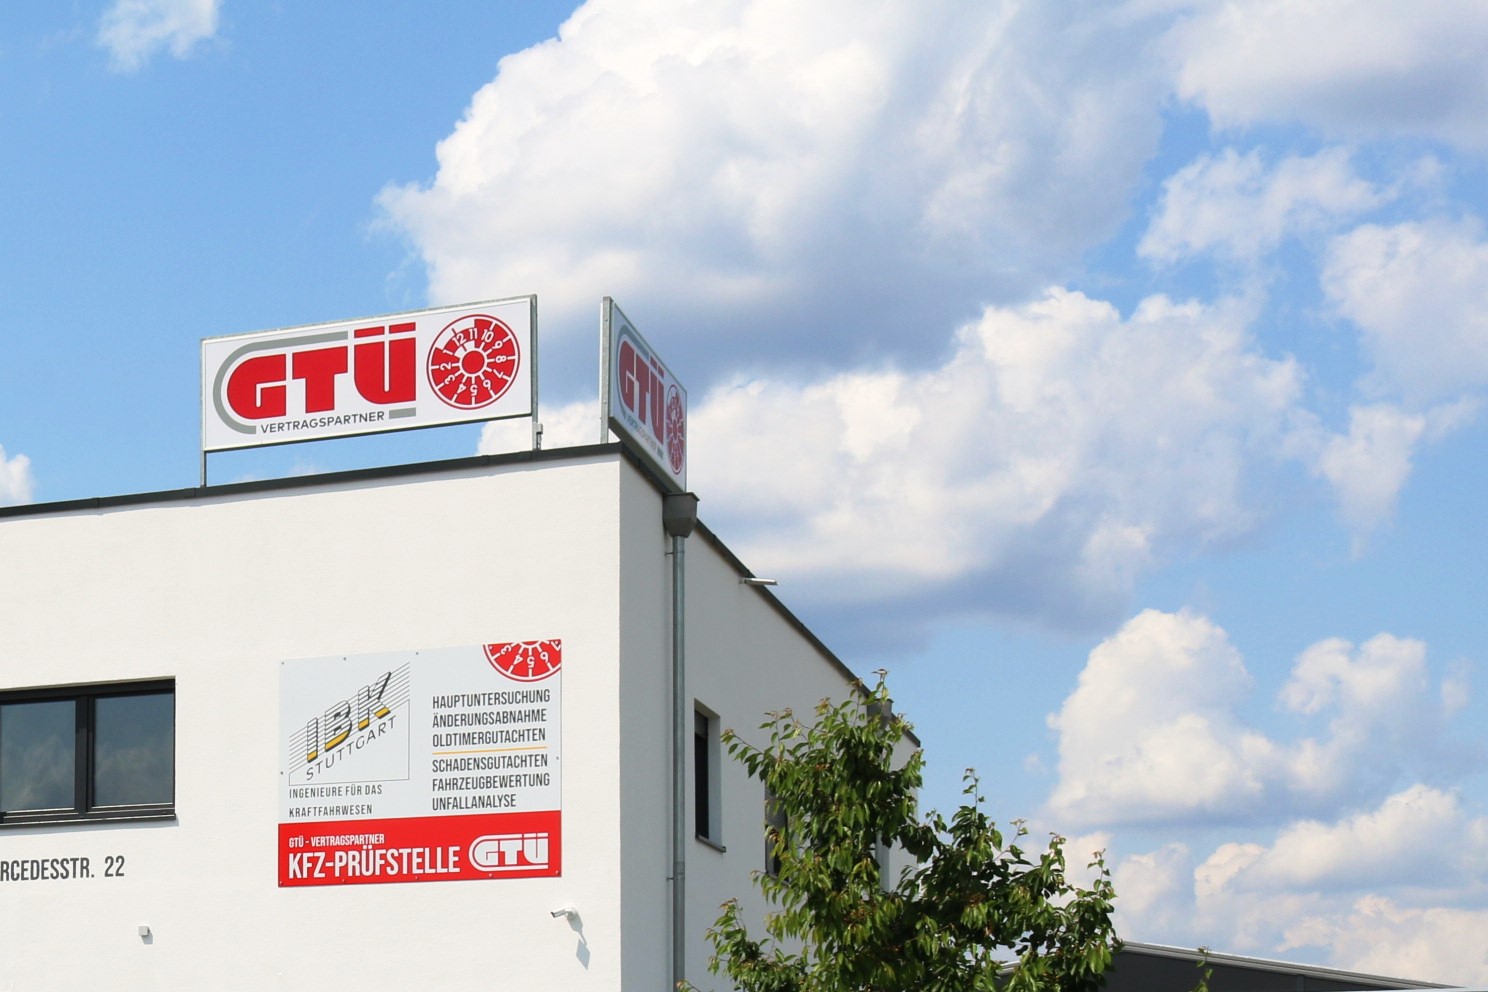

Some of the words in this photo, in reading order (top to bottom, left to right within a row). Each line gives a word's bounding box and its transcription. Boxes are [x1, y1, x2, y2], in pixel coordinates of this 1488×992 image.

[452, 333, 467, 347] 12
[469, 328, 478, 339] 11
[481, 329, 494, 343] 10
[440, 361, 451, 371] 2
[495, 355, 507, 363] 8
[226, 322, 416, 419] GTÜ
[493, 369, 504, 379] 7
[444, 374, 455, 385] 3
[456, 383, 467, 394] 4
[470, 384, 478, 396] 5
[619, 340, 665, 446] GTÜ
[260, 410, 385, 435] VERTRAGSPARTNER
[500, 644, 512, 655] 3
[512, 654, 524, 665] 4
[527, 656, 535, 668] 5
[432, 688, 551, 710] HAUPTUNTERSUCHUNG
[307, 671, 392, 763] IBK
[432, 708, 547, 728] ÄNDERUNGSABNAHME
[432, 727, 546, 748] OLDTIMERGUTACHTEN
[306, 715, 396, 781] STUTTGART
[432, 753, 548, 773] SCHADENSGUTACHTEN
[432, 772, 551, 792] FAHRZEUGBEWERTUNG
[288, 786, 343, 799] INGENIEURE
[345, 784, 362, 797] FÜR
[365, 784, 382, 796] DAS
[432, 793, 517, 811] UNFALLANALYSE
[288, 804, 373, 818] KRAFTFAHRWESEN
[288, 836, 304, 848] GTÜ
[310, 833, 385, 847] VERTRAGSPARTNER
[288, 845, 461, 879] KFZ-PRÜFSTELLE
[473, 832, 548, 866] GTÜ
[104, 855, 125, 877] 22
